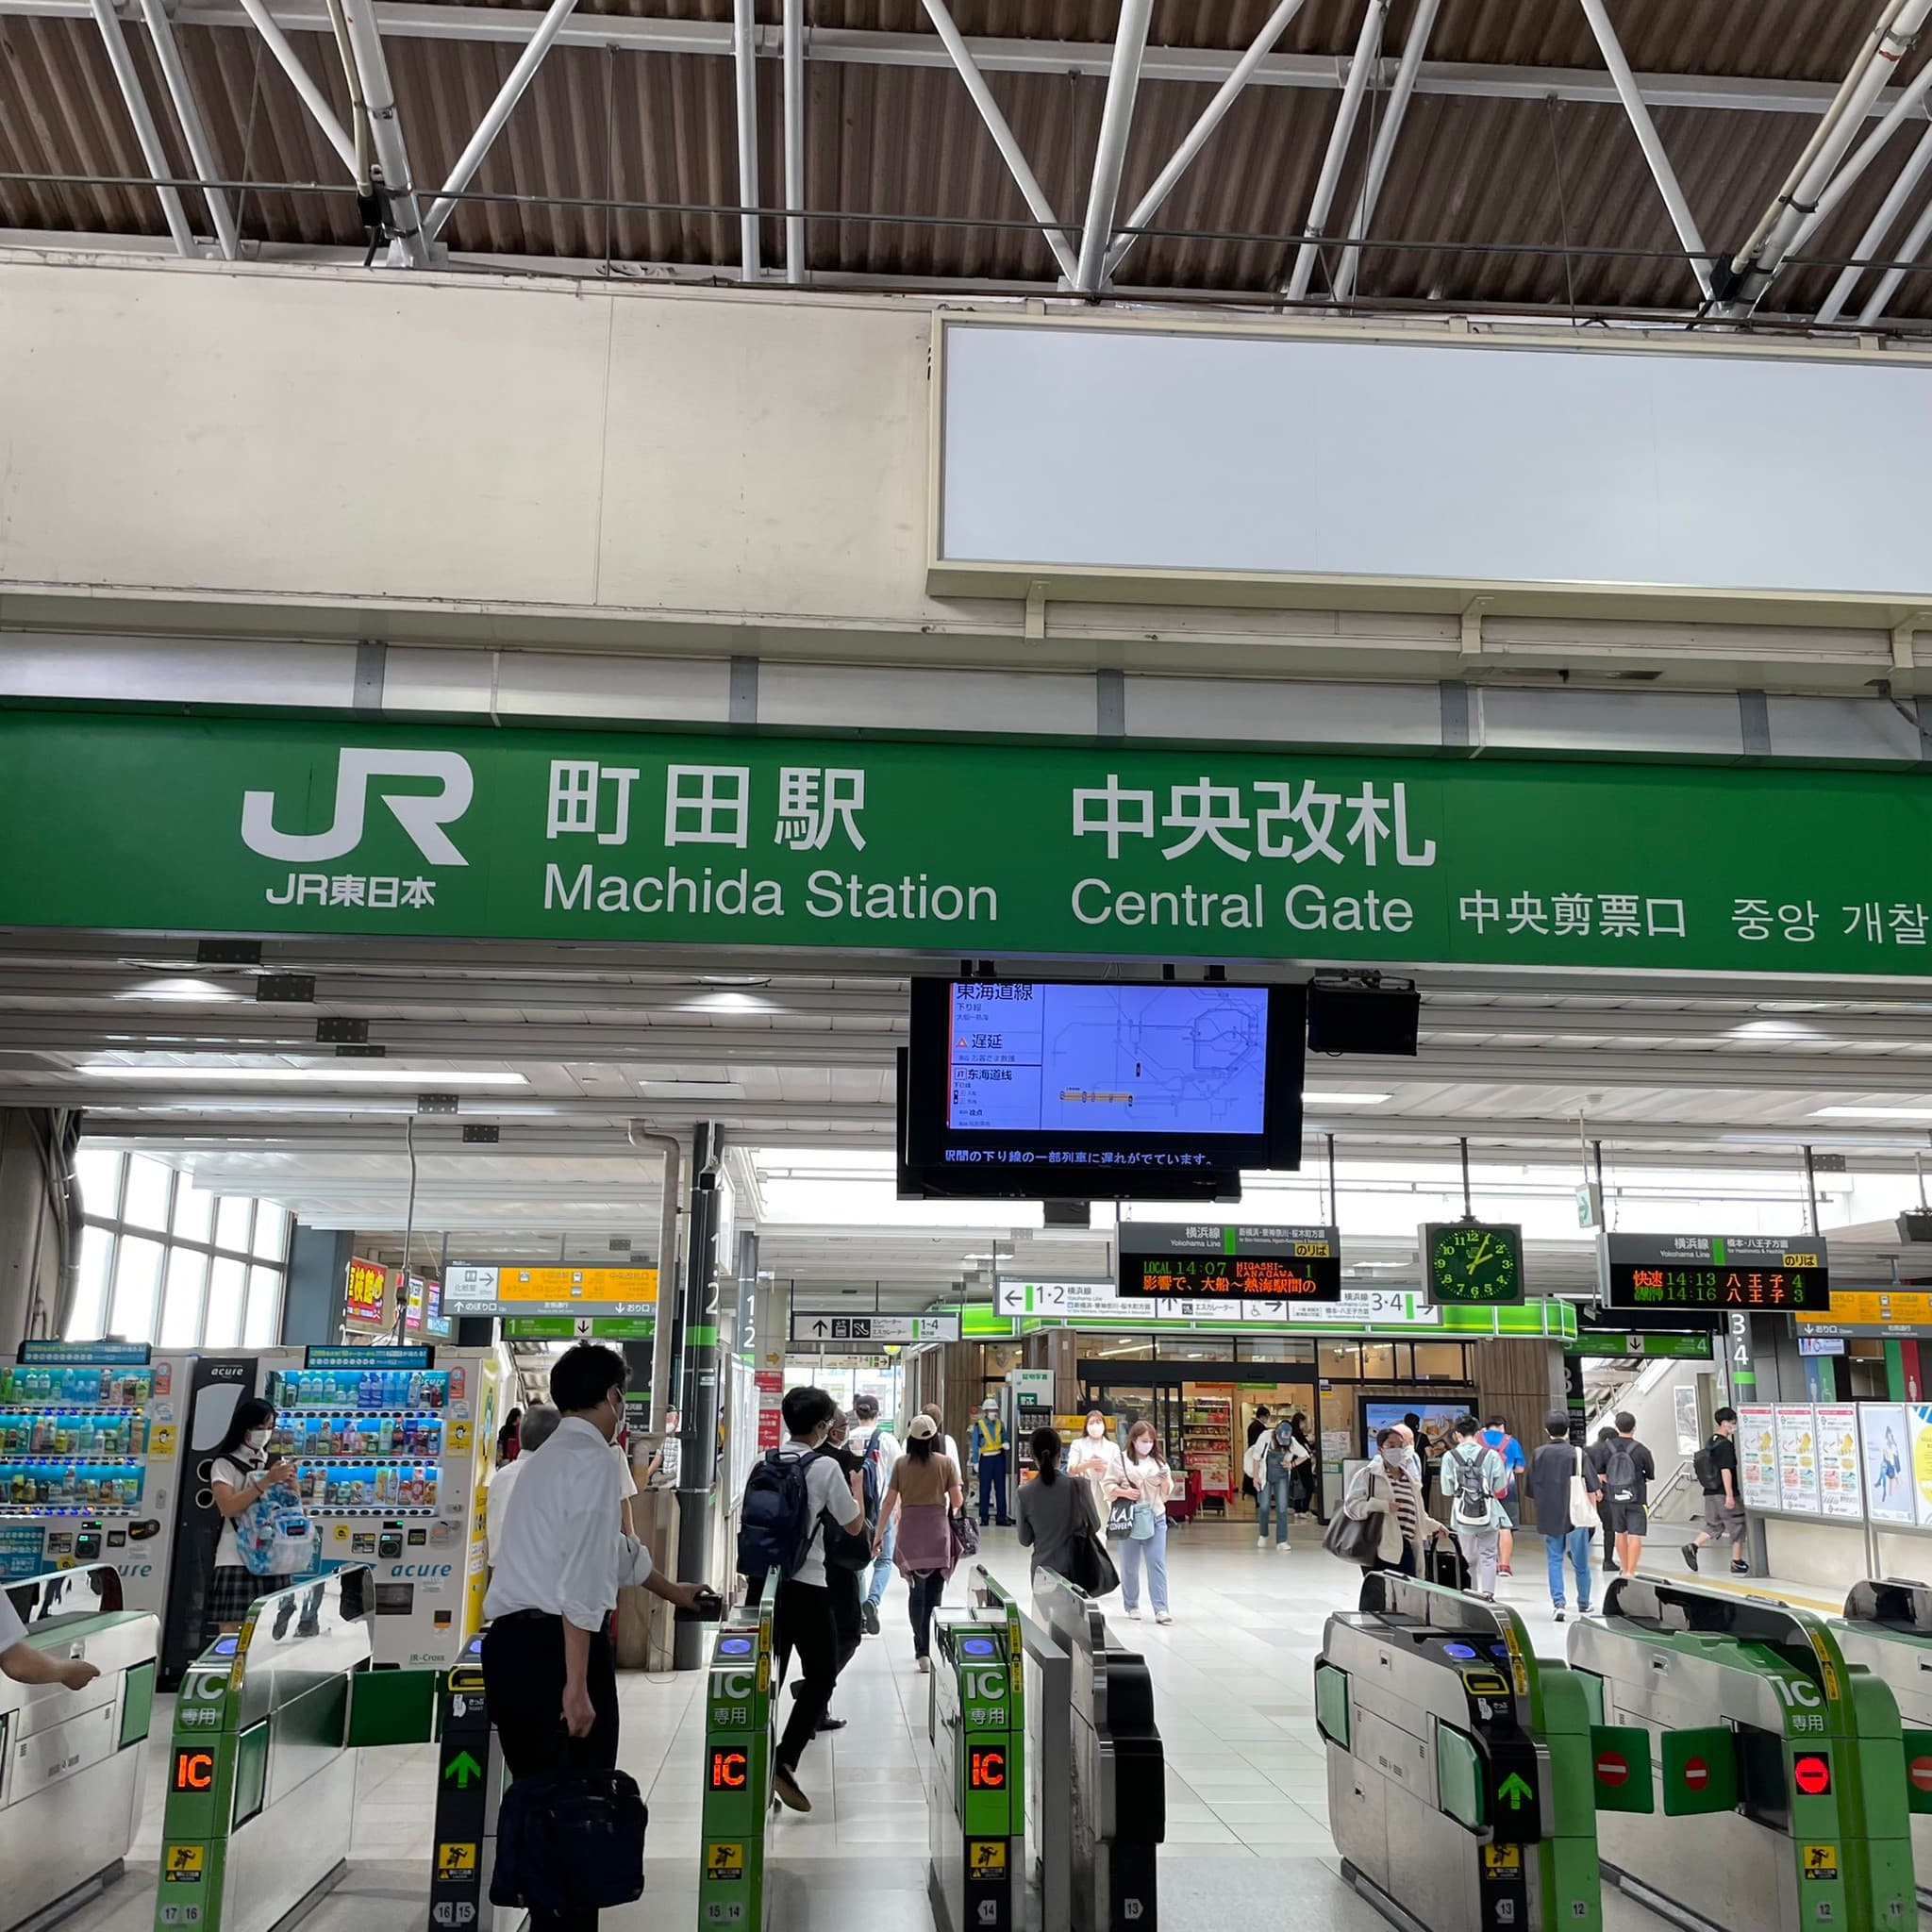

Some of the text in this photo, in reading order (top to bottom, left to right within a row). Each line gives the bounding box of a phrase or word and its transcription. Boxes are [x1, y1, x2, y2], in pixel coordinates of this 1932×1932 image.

[241, 747, 474, 865] JR
[546, 760, 867, 851] 町田駅
[1072, 774, 1437, 868] 中央改札
[265, 874, 437, 909] JR東日本
[543, 863, 998, 922] Machida Station
[1071, 878, 1414, 934] Central Gate
[1458, 890, 1687, 940] 中央剪票口
[1731, 898, 1930, 945] 중앙 개찰
[956, 983, 1033, 1001] 東海道線
[972, 1034, 1003, 1049] 遅延
[968, 1069, 1012, 1080] 东海道线
[1185, 1226, 1221, 1239] 横浜線
[1467, 1232, 1479, 1241] 12
[1170, 1239, 1206, 1248] Yokohama
[1455, 1237, 1465, 1245] 11
[1674, 1238, 1709, 1250] 横浜線
[1296, 1244, 1327, 1256] のりば
[1443, 1246, 1455, 1255] 10
[1495, 1244, 1504, 1254] 2
[1659, 1250, 1695, 1258] Yokohama
[1143, 1260, 1226, 1274] LOCAL 14:07
[1437, 1258, 1446, 1268] 9
[1502, 1259, 1510, 1269] 3
[1784, 1256, 1816, 1267] のりば
[1236, 1270, 1293, 1278] KANAGAWA
[1305, 1264, 1312, 1277] 1
[1443, 1274, 1453, 1283] 8
[1496, 1274, 1506, 1284] 4
[1633, 1270, 1804, 1288] 快速 14:13 八王子 4
[1457, 1283, 1465, 1292] 7
[1470, 1286, 1479, 1295] 6
[1484, 1283, 1492, 1292] 5
[1668, 1288, 1717, 1301] 14:16
[1726, 1289, 1785, 1303] 八王子
[1793, 1290, 1804, 1303] 3
[465, 1303, 497, 1311] のぼり口
[626, 1304, 650, 1312] おり口
[509, 1319, 516, 1334] 1
[1815, 1324, 1838, 1333] おり口
[1697, 1338, 1707, 1352] 4
[211, 1367, 243, 1375] acure
[391, 1563, 453, 1577] acure
[185, 1672, 228, 1699] IC
[714, 1672, 752, 1699] IC
[966, 1672, 1005, 1699] IC
[1778, 1679, 1821, 1707] IC
[181, 1707, 217, 1725] 専用
[713, 1707, 747, 1724] 専用
[970, 1708, 1005, 1725] 専用
[1790, 1714, 1824, 1732] 専用
[177, 1754, 212, 1788] IC
[713, 1754, 745, 1786] IC
[973, 1753, 1004, 1785] IC
[164, 1907, 176, 1921] 17
[185, 1907, 197, 1920] 16
[438, 1906, 451, 1919] 16
[458, 1906, 471, 1918] 15
[708, 1906, 721, 1918] 15
[728, 1906, 740, 1917] 14
[984, 1904, 994, 1917] 14
[1126, 1904, 1139, 1915] 13
[1500, 1903, 1511, 1915] 13
[1573, 1903, 1585, 1914] 12
[1819, 1904, 1831, 1915] 12
[1890, 1903, 1901, 1915] 11
